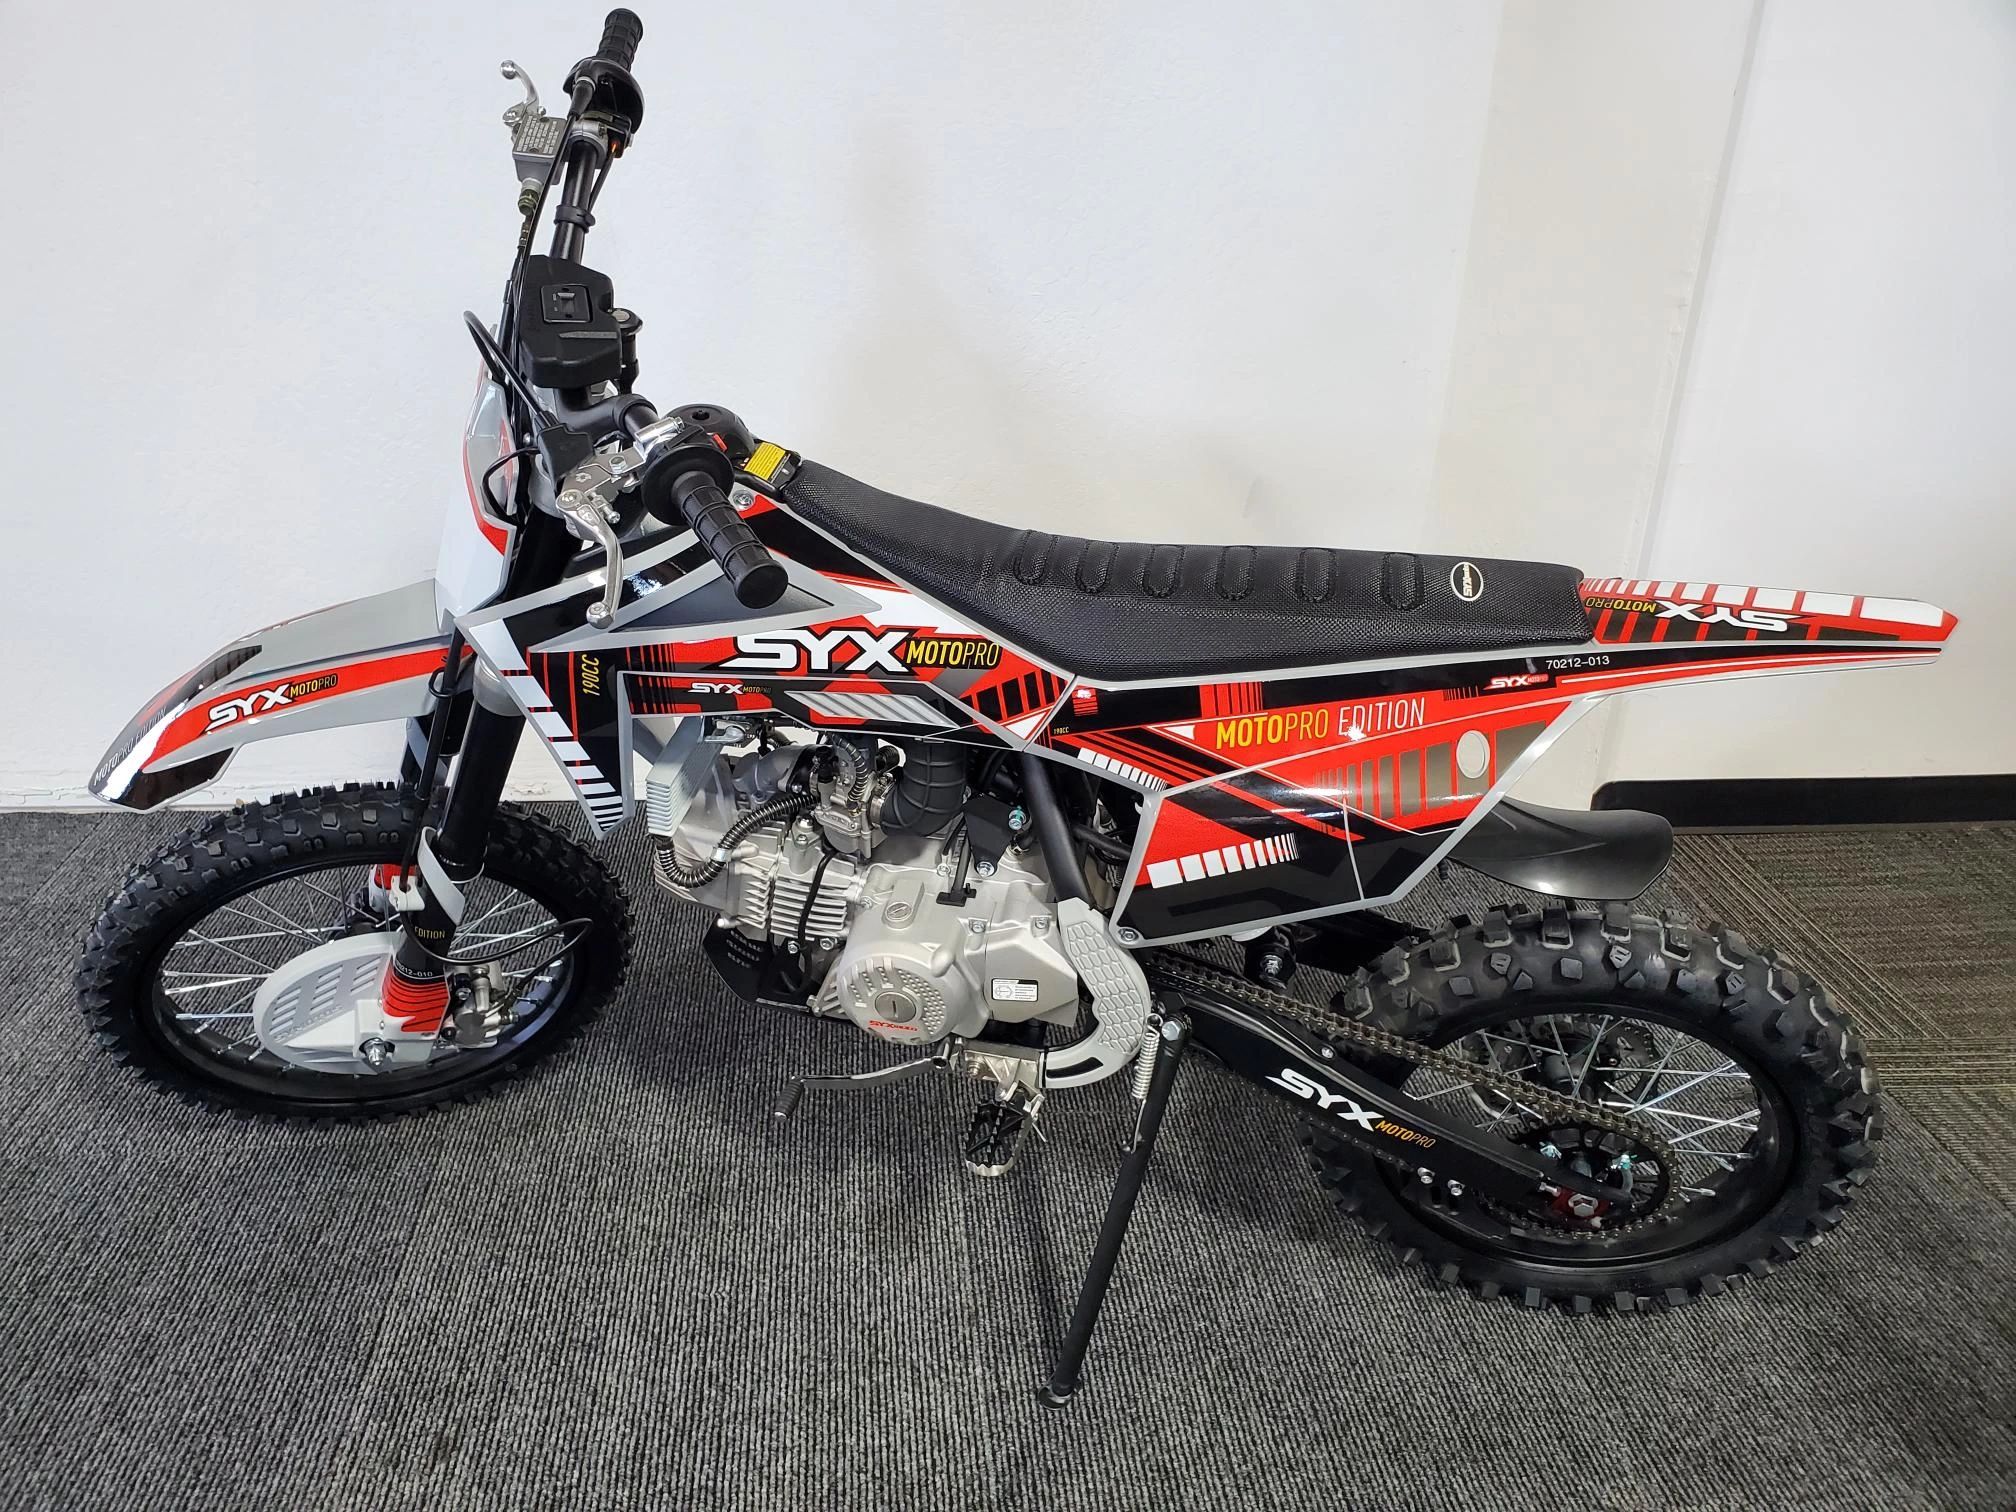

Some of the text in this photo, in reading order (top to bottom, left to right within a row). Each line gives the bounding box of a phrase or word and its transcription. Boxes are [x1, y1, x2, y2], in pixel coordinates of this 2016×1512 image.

[1586, 597, 1801, 632] SYX MOTOPRO
[719, 629, 1000, 672] SYX MOTOPRO
[1546, 656, 1610, 669] 70212-013
[582, 654, 600, 696] 190CC
[688, 682, 744, 694] SYX
[1484, 675, 1530, 690] SYX
[204, 674, 337, 731] SYX MOTOPRO
[1216, 697, 1425, 749] MOTOPRO EDITION
[414, 926, 446, 939] EDITION
[1265, 1068, 1436, 1148] SYX MOTOPRO
